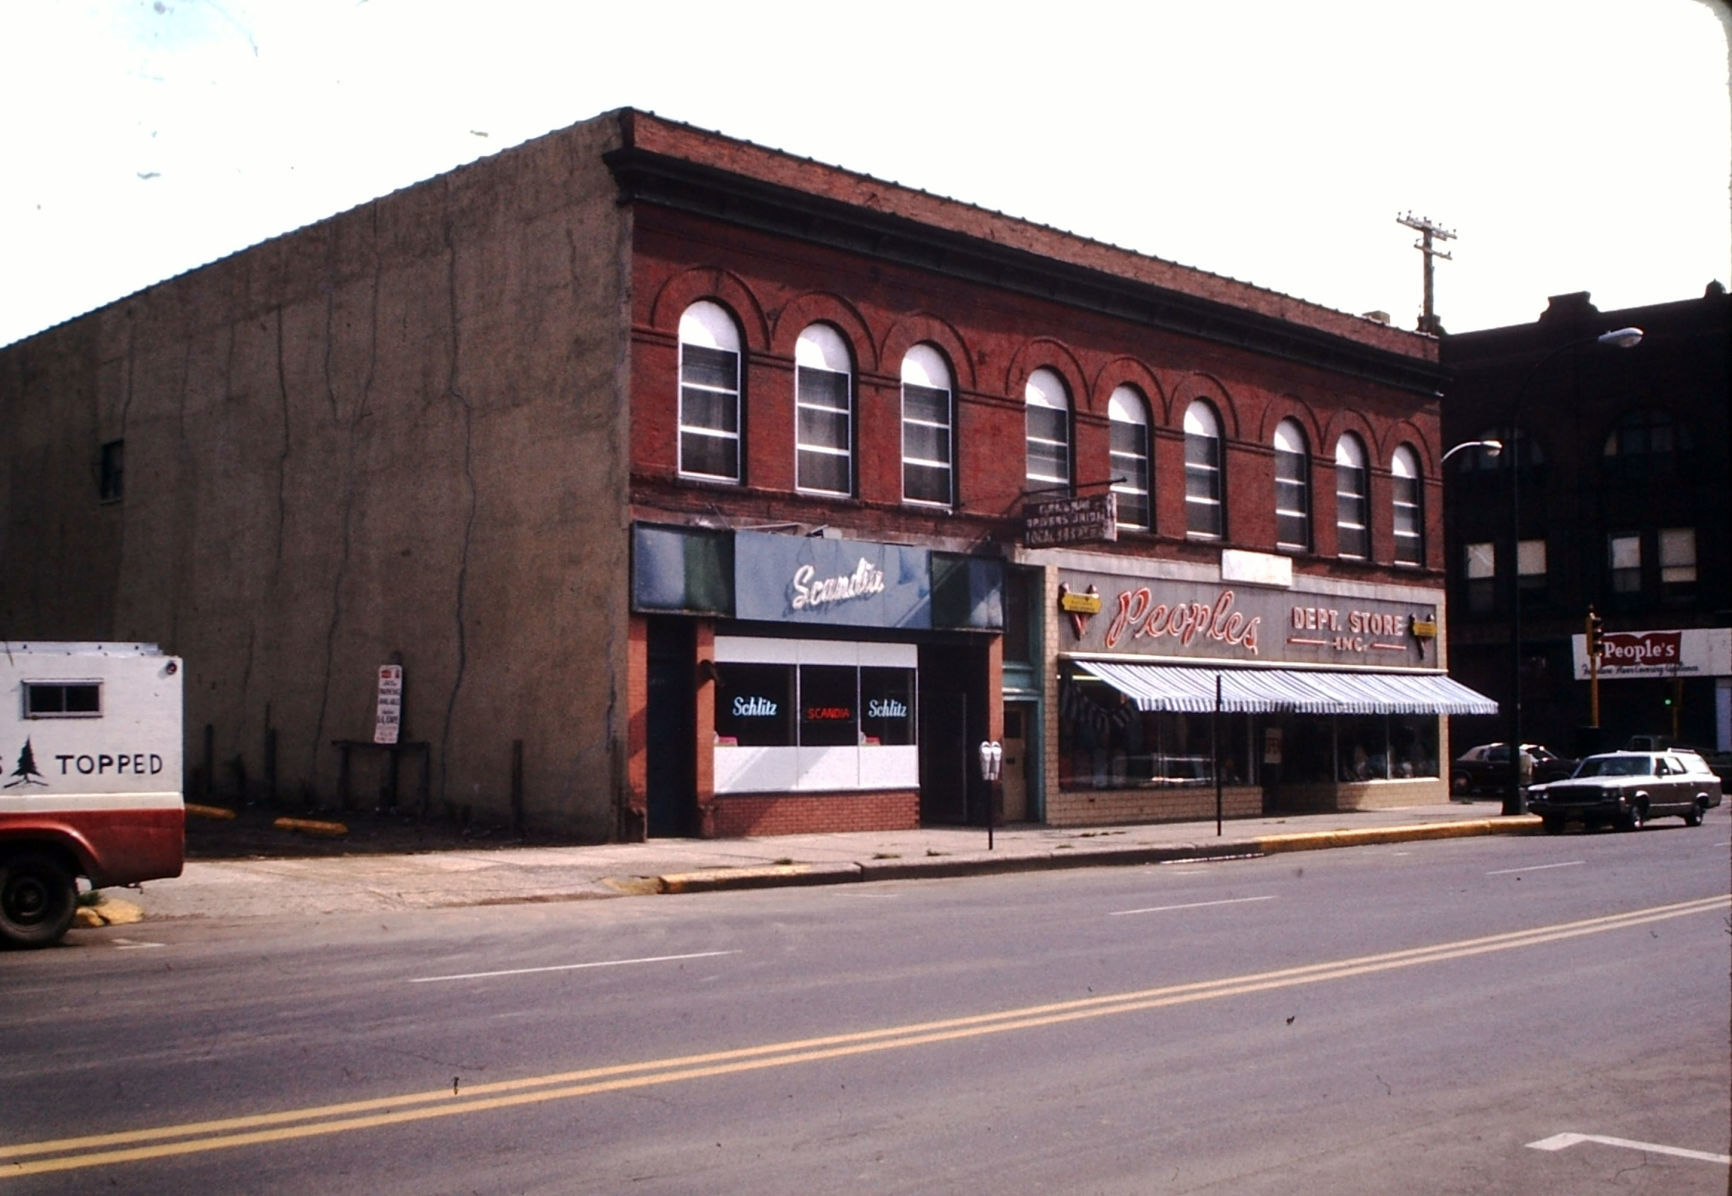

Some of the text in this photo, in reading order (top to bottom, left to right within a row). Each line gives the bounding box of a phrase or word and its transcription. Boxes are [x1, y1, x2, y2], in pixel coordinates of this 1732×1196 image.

[792, 557, 885, 609] Scandia
[1105, 586, 1261, 656] Peoples
[1291, 606, 1343, 632] DEPT.
[1348, 610, 1405, 637] STORE
[1603, 639, 1675, 662] People's
[732, 696, 778, 716] Schlitz
[807, 707, 850, 720] SCANDIA
[868, 699, 908, 718] Schlitz
[55, 754, 163, 775] TOPPED
